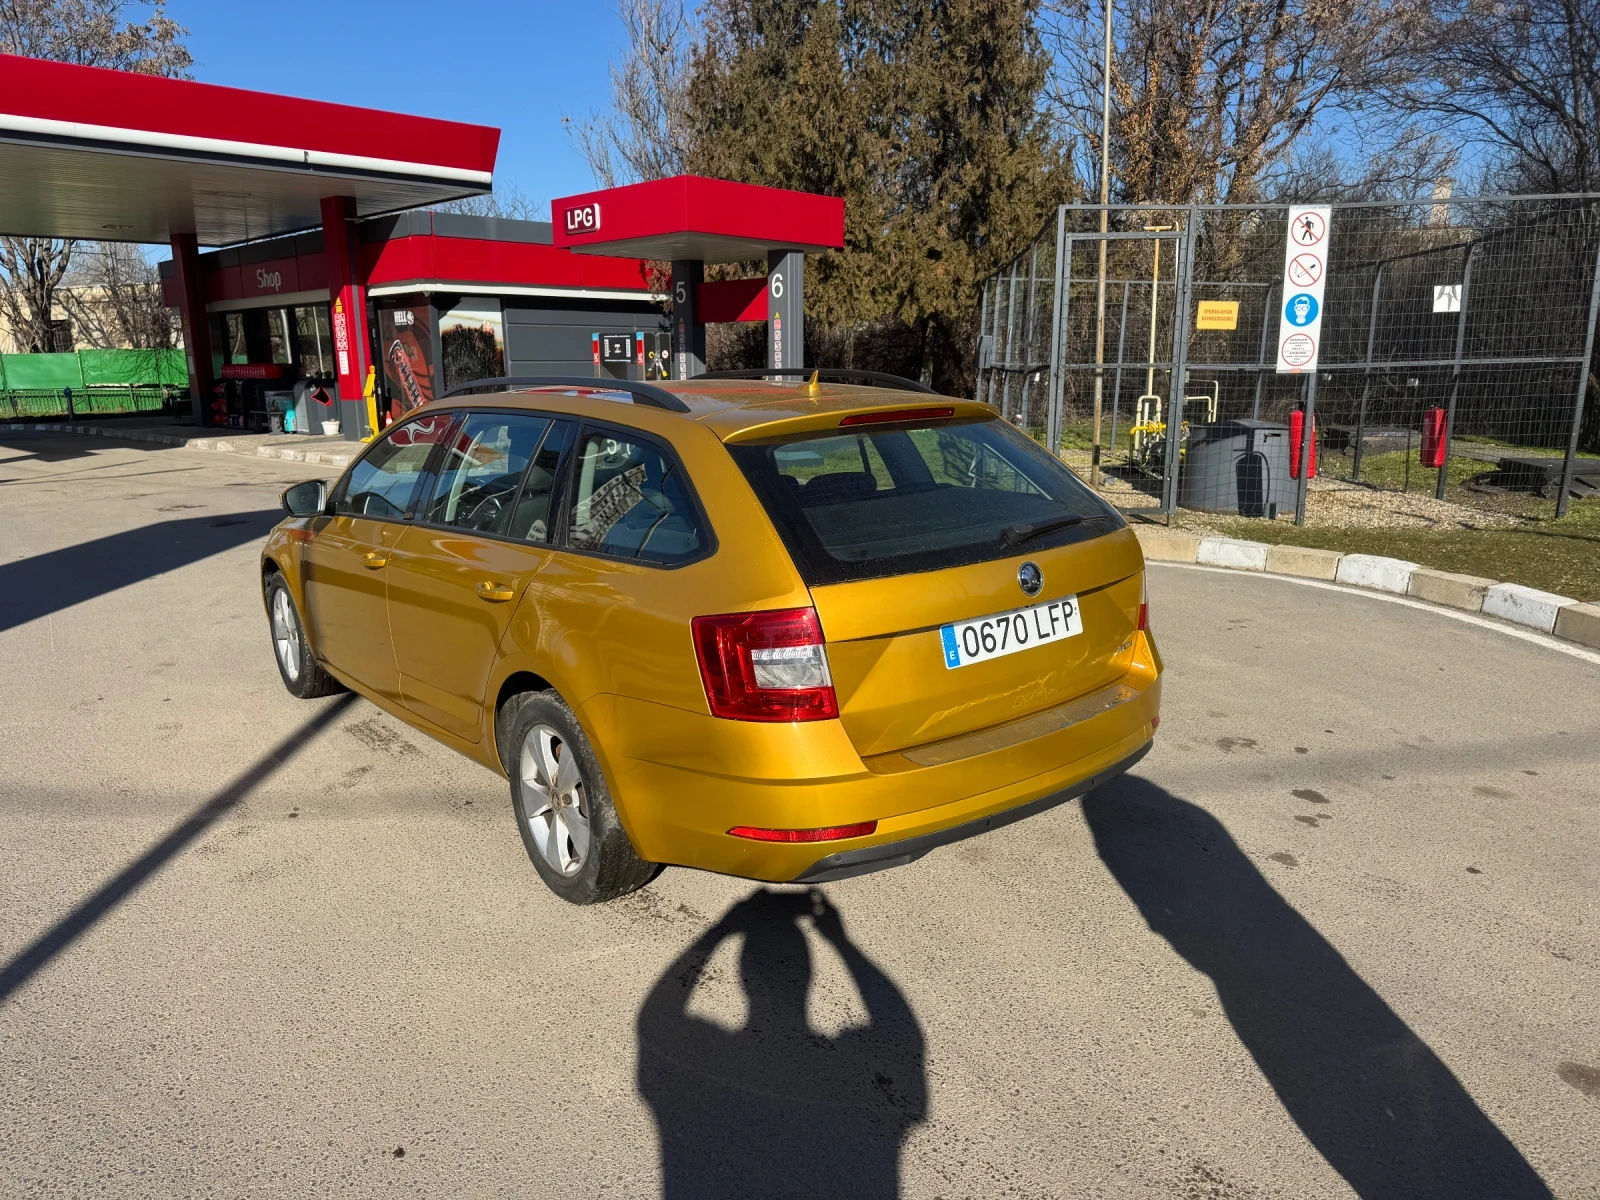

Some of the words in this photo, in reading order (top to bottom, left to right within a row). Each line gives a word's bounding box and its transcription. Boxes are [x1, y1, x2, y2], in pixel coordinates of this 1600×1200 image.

[567, 207, 593, 230] LPG
[256, 268, 281, 291] Shop
[771, 273, 784, 298] 6
[675, 281, 686, 303] 5
[394, 310, 407, 323] HELL
[962, 614, 1028, 657] 0670
[1034, 601, 1073, 640] LFP
[949, 650, 956, 661] E
